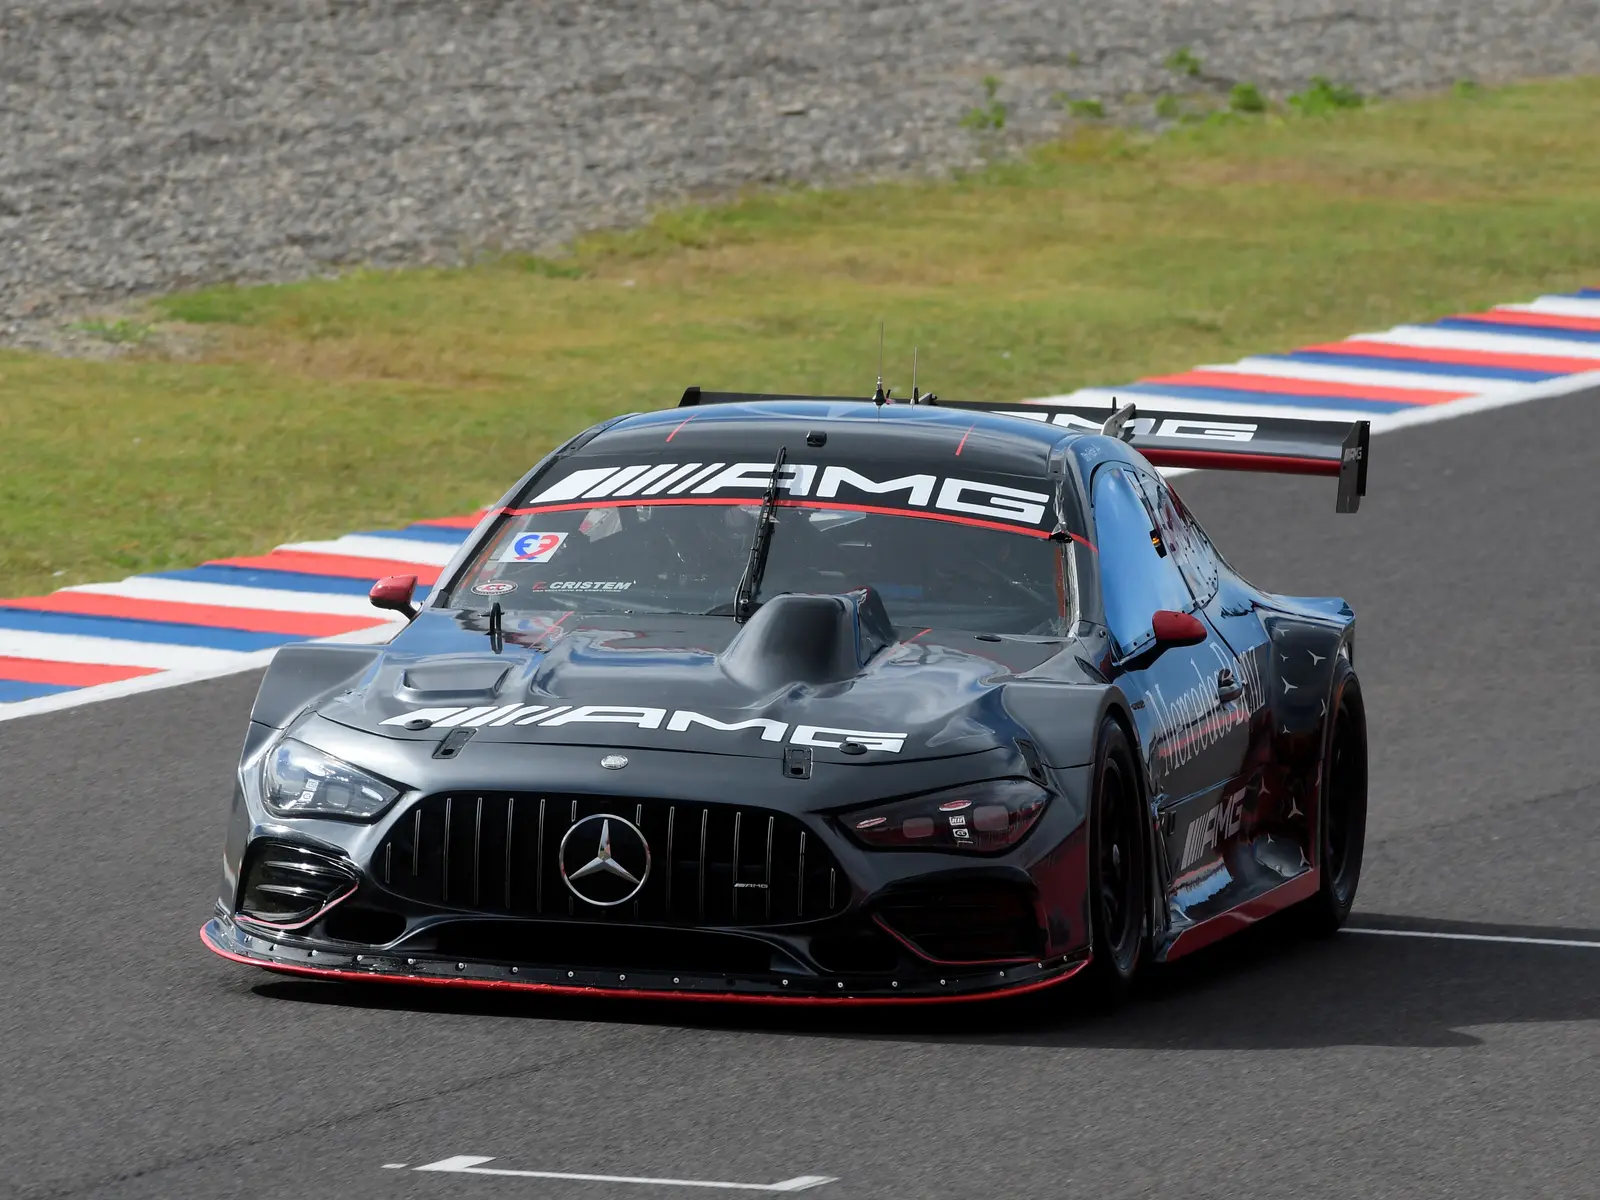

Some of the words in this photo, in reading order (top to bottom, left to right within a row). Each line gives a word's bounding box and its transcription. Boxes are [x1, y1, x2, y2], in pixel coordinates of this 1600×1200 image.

[690, 463, 1050, 525] AMG
[549, 581, 633, 590] CRISTEM
[537, 706, 908, 754] AMG
[1200, 787, 1247, 858] AMG
